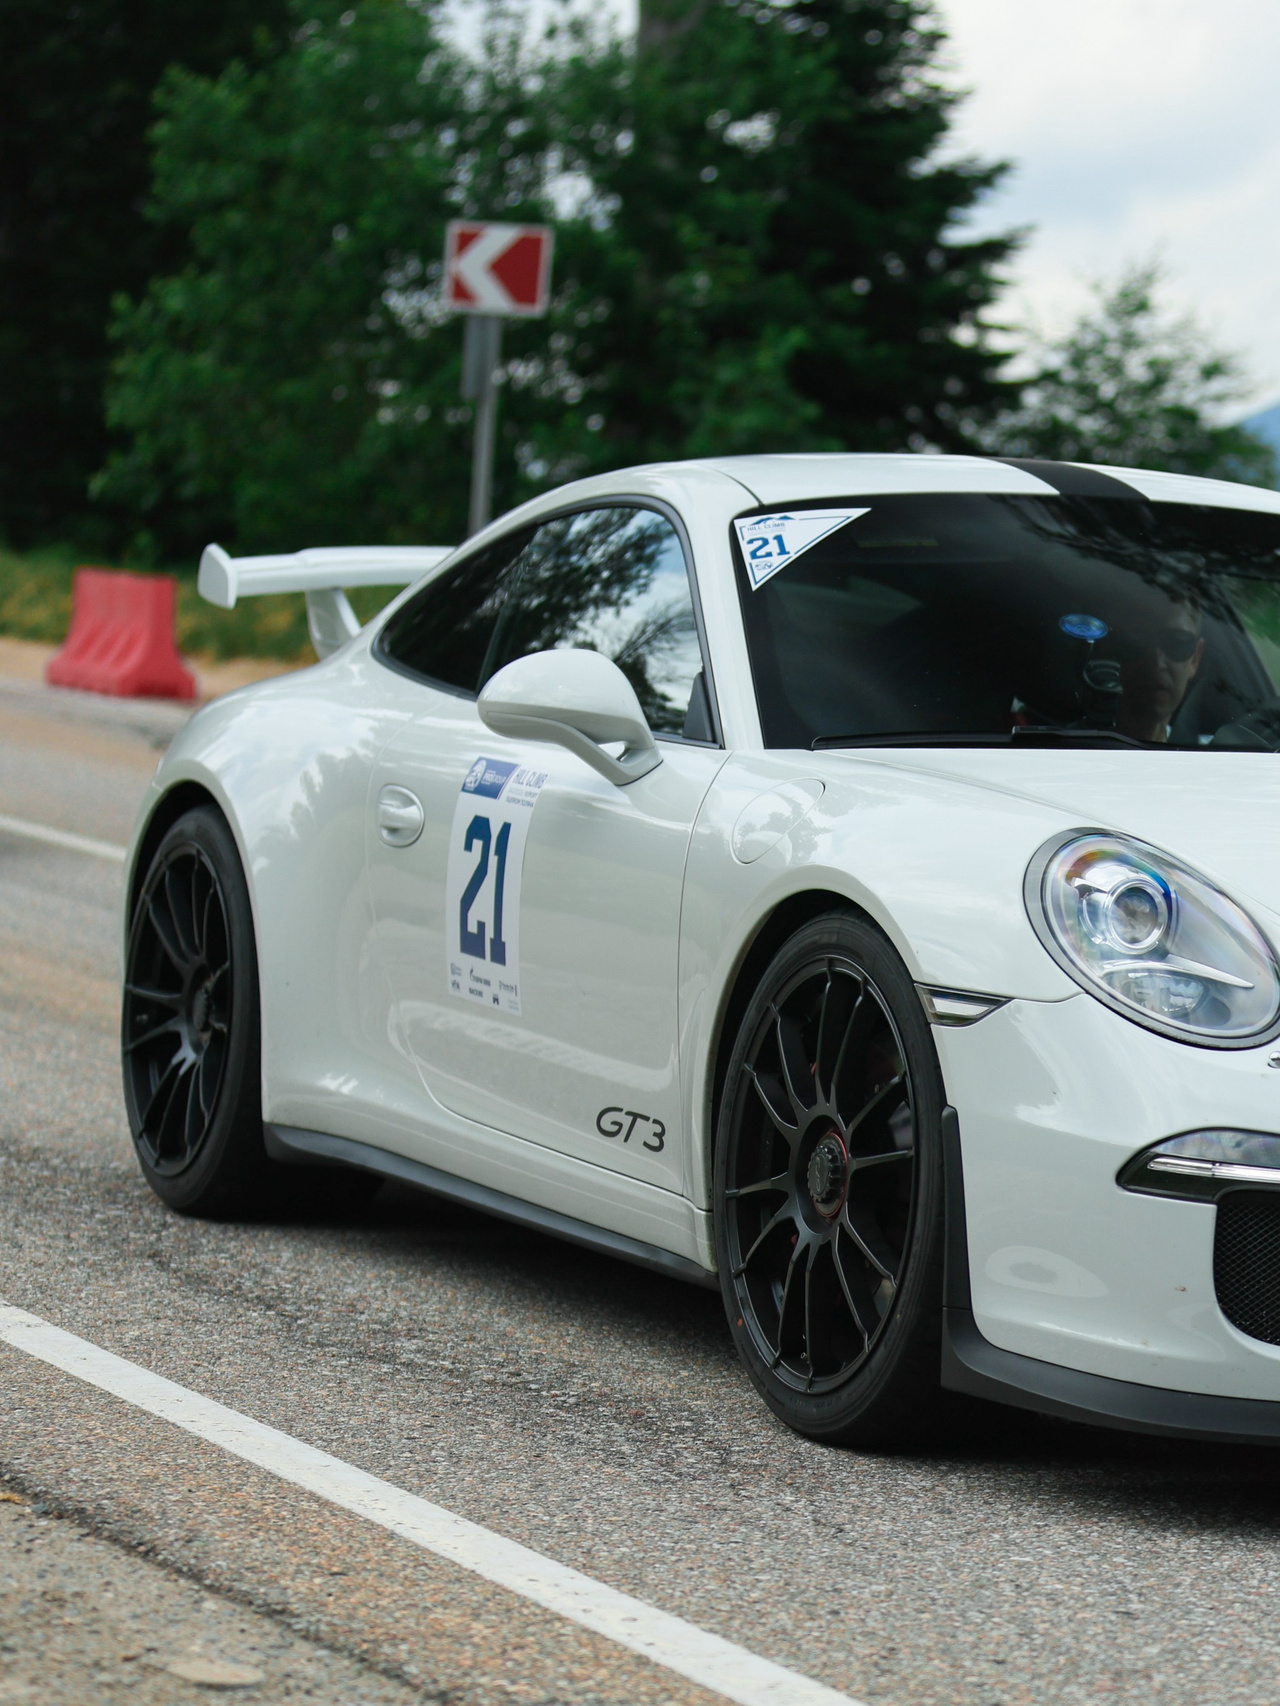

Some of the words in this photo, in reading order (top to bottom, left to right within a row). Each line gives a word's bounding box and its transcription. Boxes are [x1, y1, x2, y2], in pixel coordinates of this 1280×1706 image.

[746, 534, 790, 560] 21
[460, 814, 512, 967] 21
[595, 1106, 666, 1153] GT3
